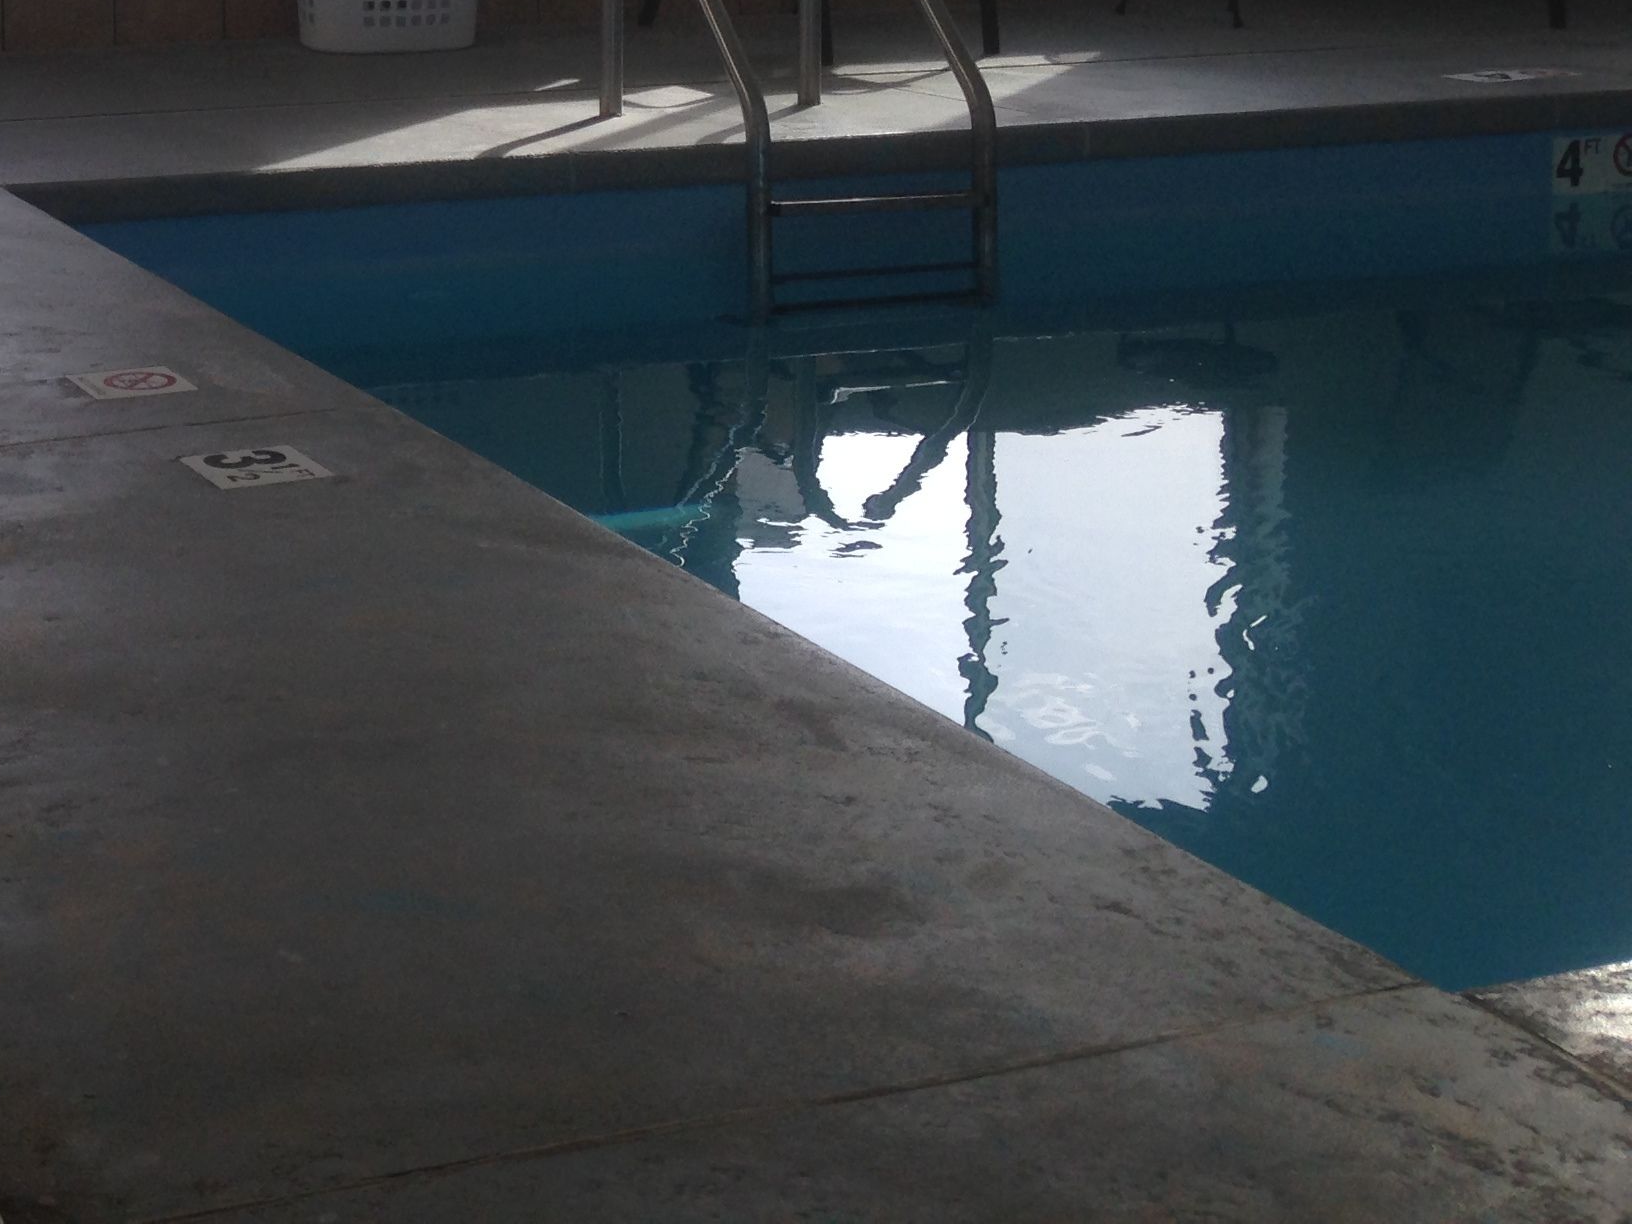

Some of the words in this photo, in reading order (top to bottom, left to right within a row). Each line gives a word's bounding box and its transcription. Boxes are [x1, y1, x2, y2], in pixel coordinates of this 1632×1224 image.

[1556, 139, 1584, 187] 4
[1584, 137, 1602, 154] FT
[202, 450, 287, 469] 3
